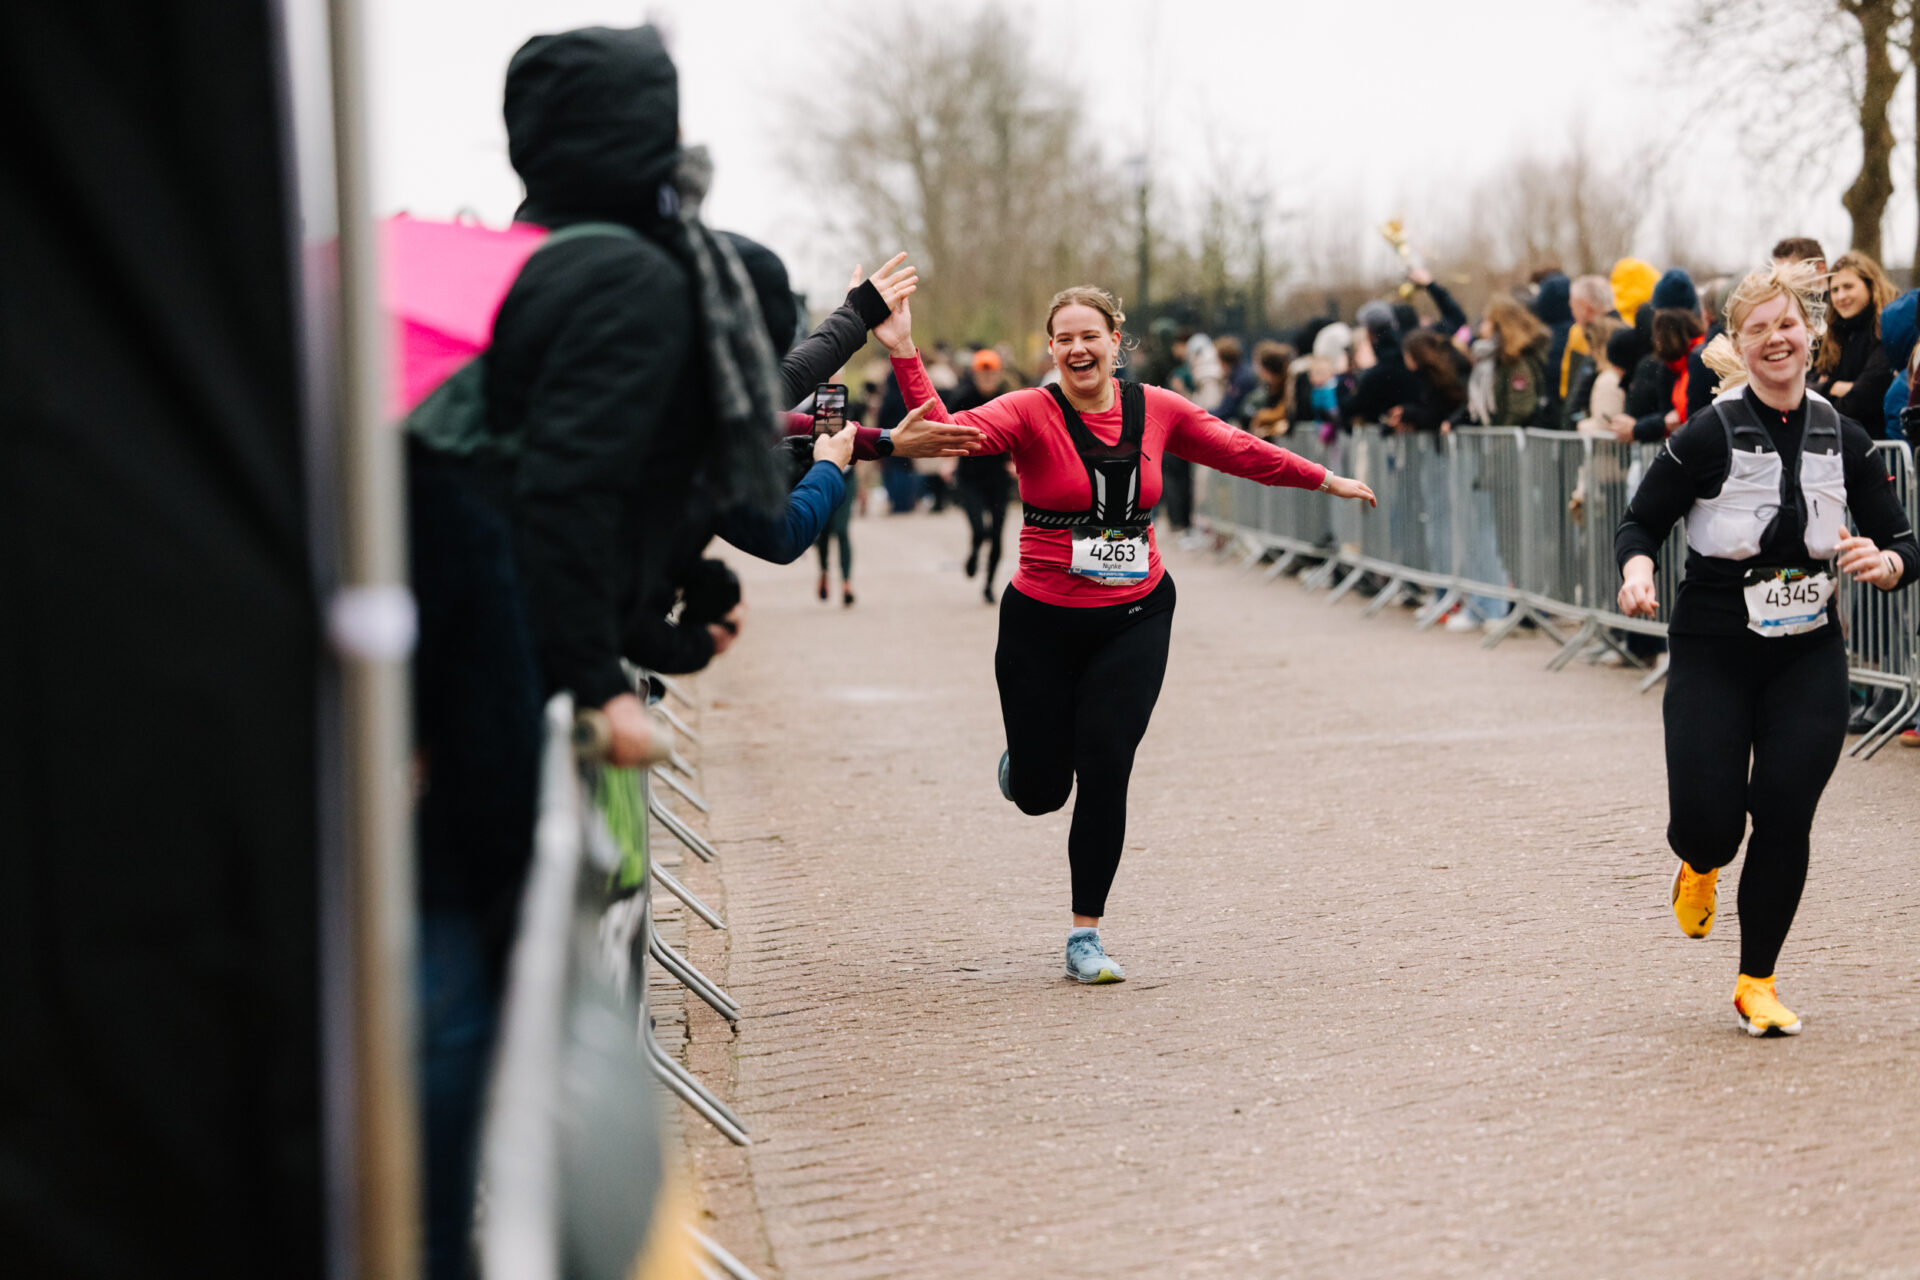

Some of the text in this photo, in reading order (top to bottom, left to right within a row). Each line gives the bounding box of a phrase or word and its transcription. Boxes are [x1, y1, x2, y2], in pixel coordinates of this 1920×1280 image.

[1090, 544, 1136, 562] 4263
[1102, 563, 1122, 571] Nynke
[1766, 583, 1820, 607] 4345
